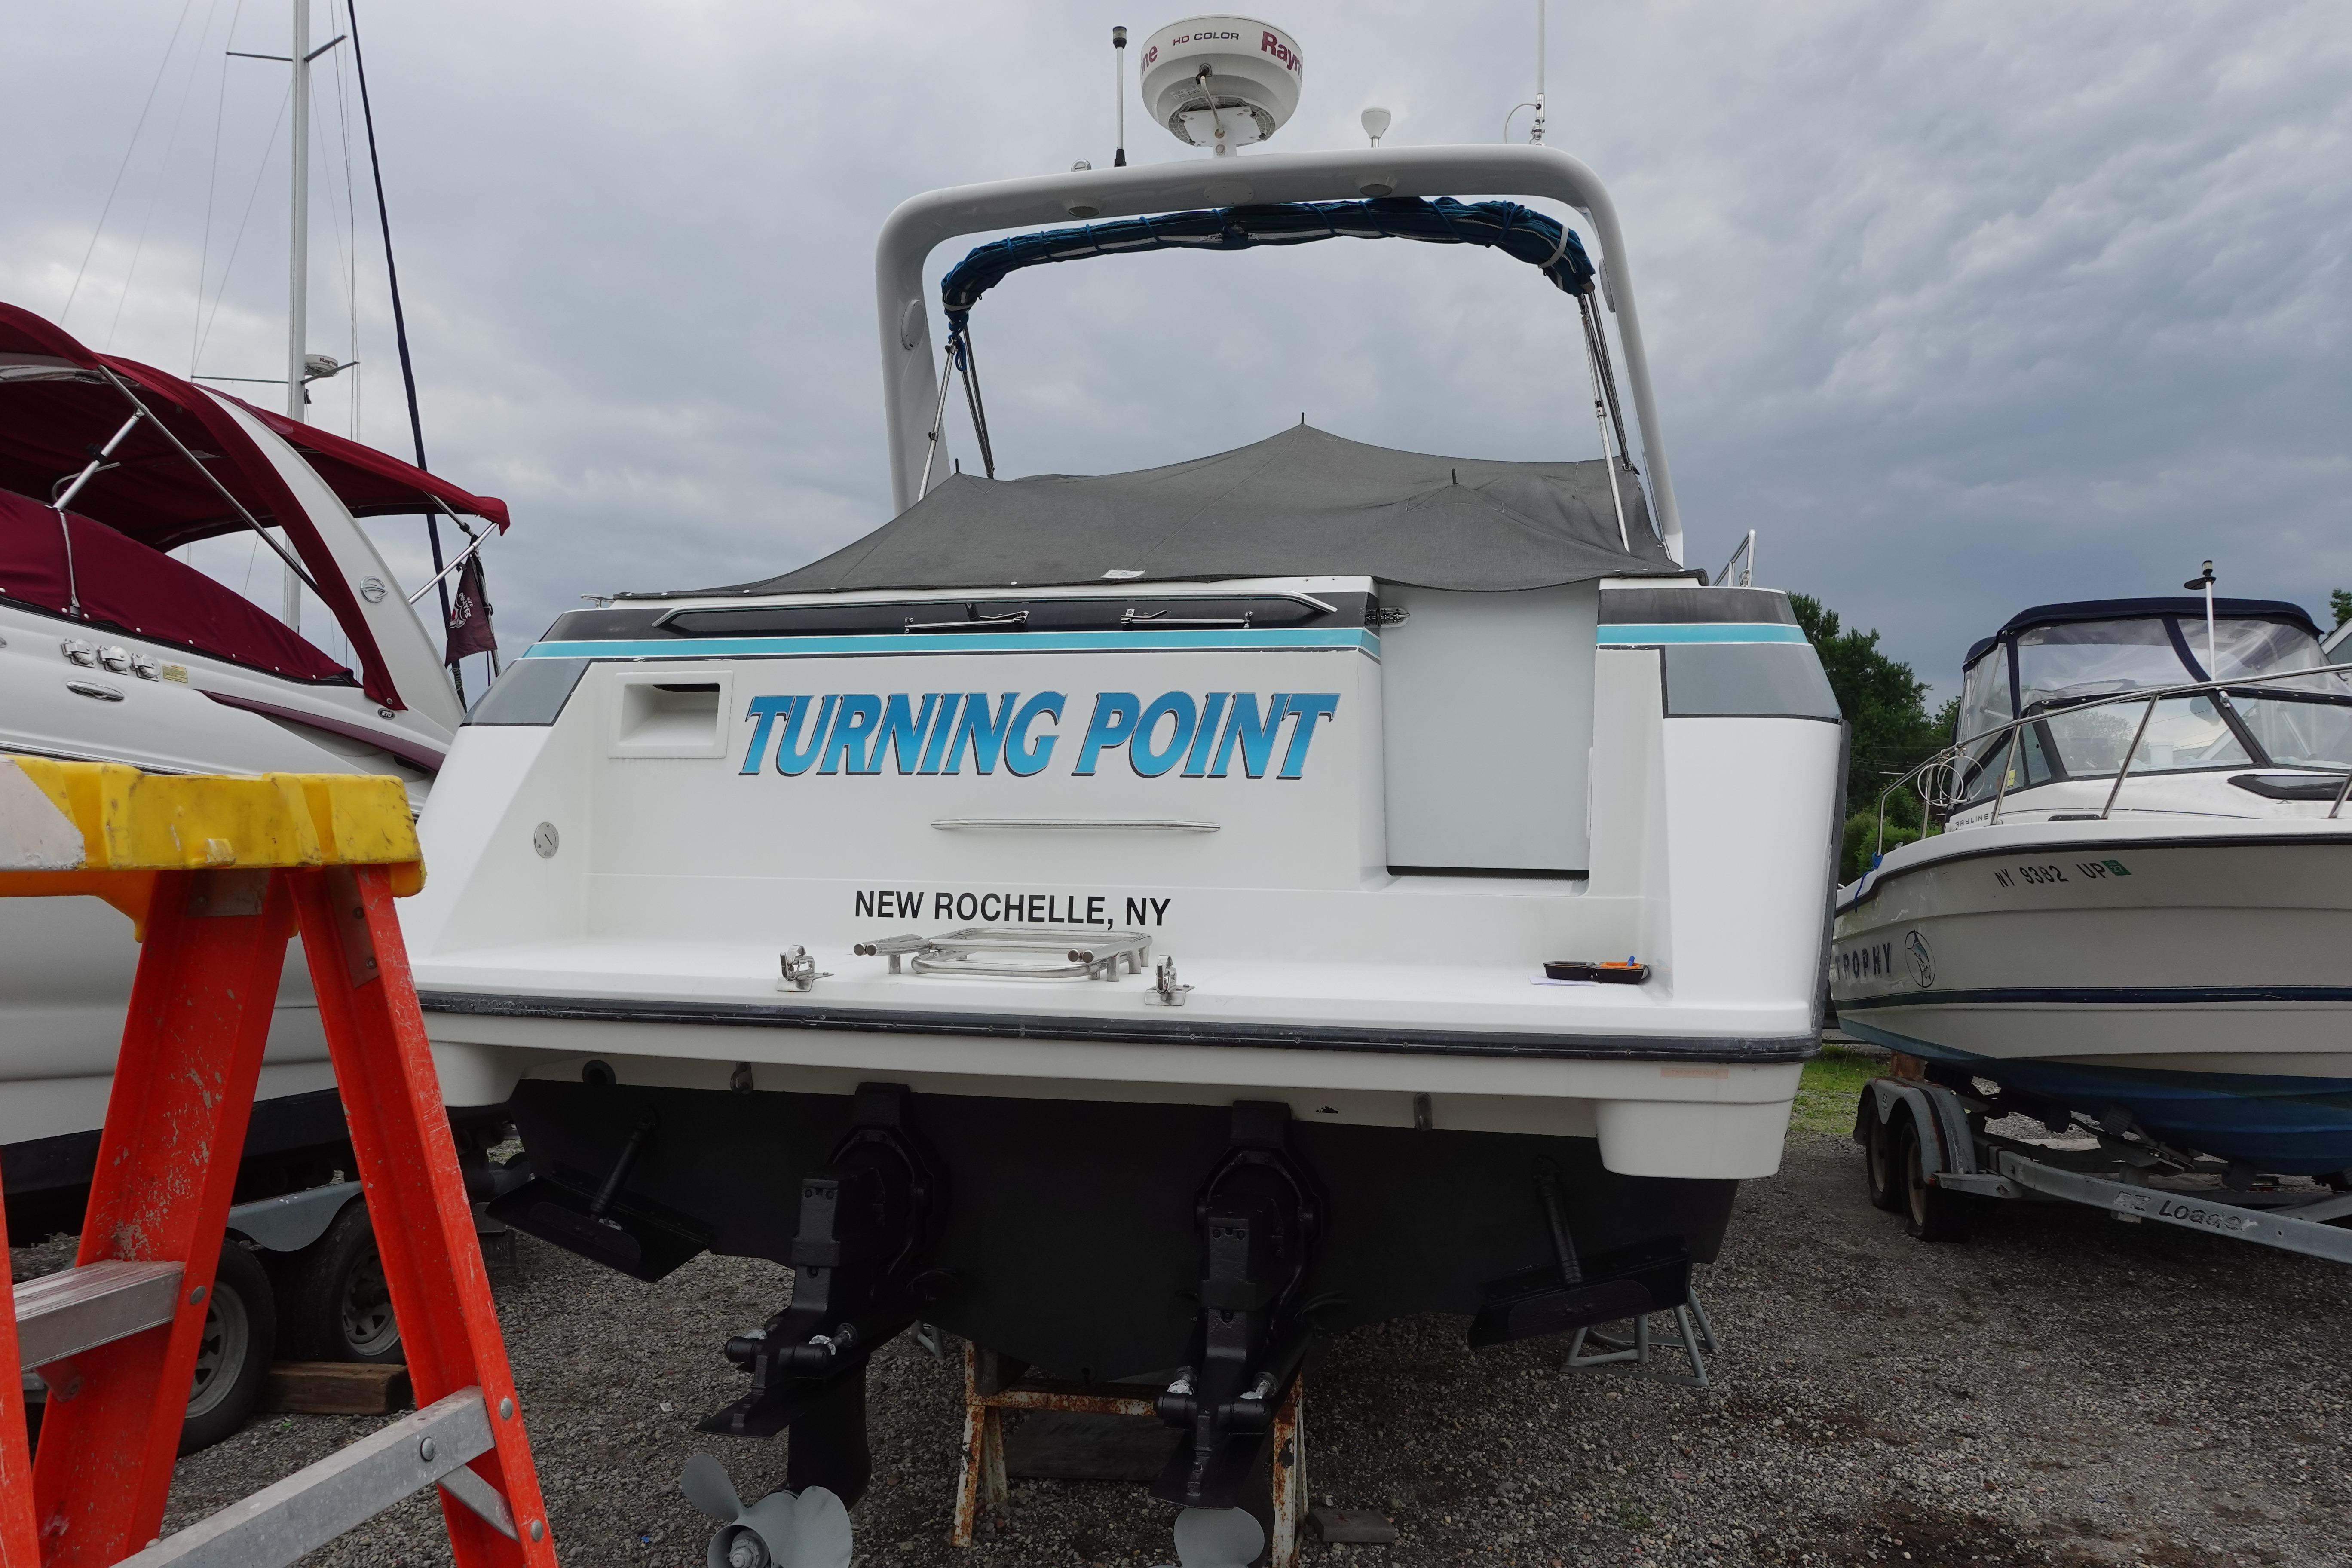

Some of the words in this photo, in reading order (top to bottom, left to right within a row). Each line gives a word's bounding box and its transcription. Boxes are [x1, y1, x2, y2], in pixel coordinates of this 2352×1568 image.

[1173, 35, 1189, 46] HD
[1194, 32, 1239, 40] COLOR
[738, 690, 1068, 777] TURNING
[1071, 690, 1341, 780] POINT
[1994, 869, 2015, 887] NY
[2019, 865, 2069, 884] 9382
[2075, 863, 2106, 878] UP
[855, 890, 924, 919] NEW
[934, 892, 1113, 931] ROCHELLE,
[1126, 897, 1171, 926] NY
[1835, 942, 1890, 980] TROPHY
[2159, 1200, 2258, 1232] Loader
